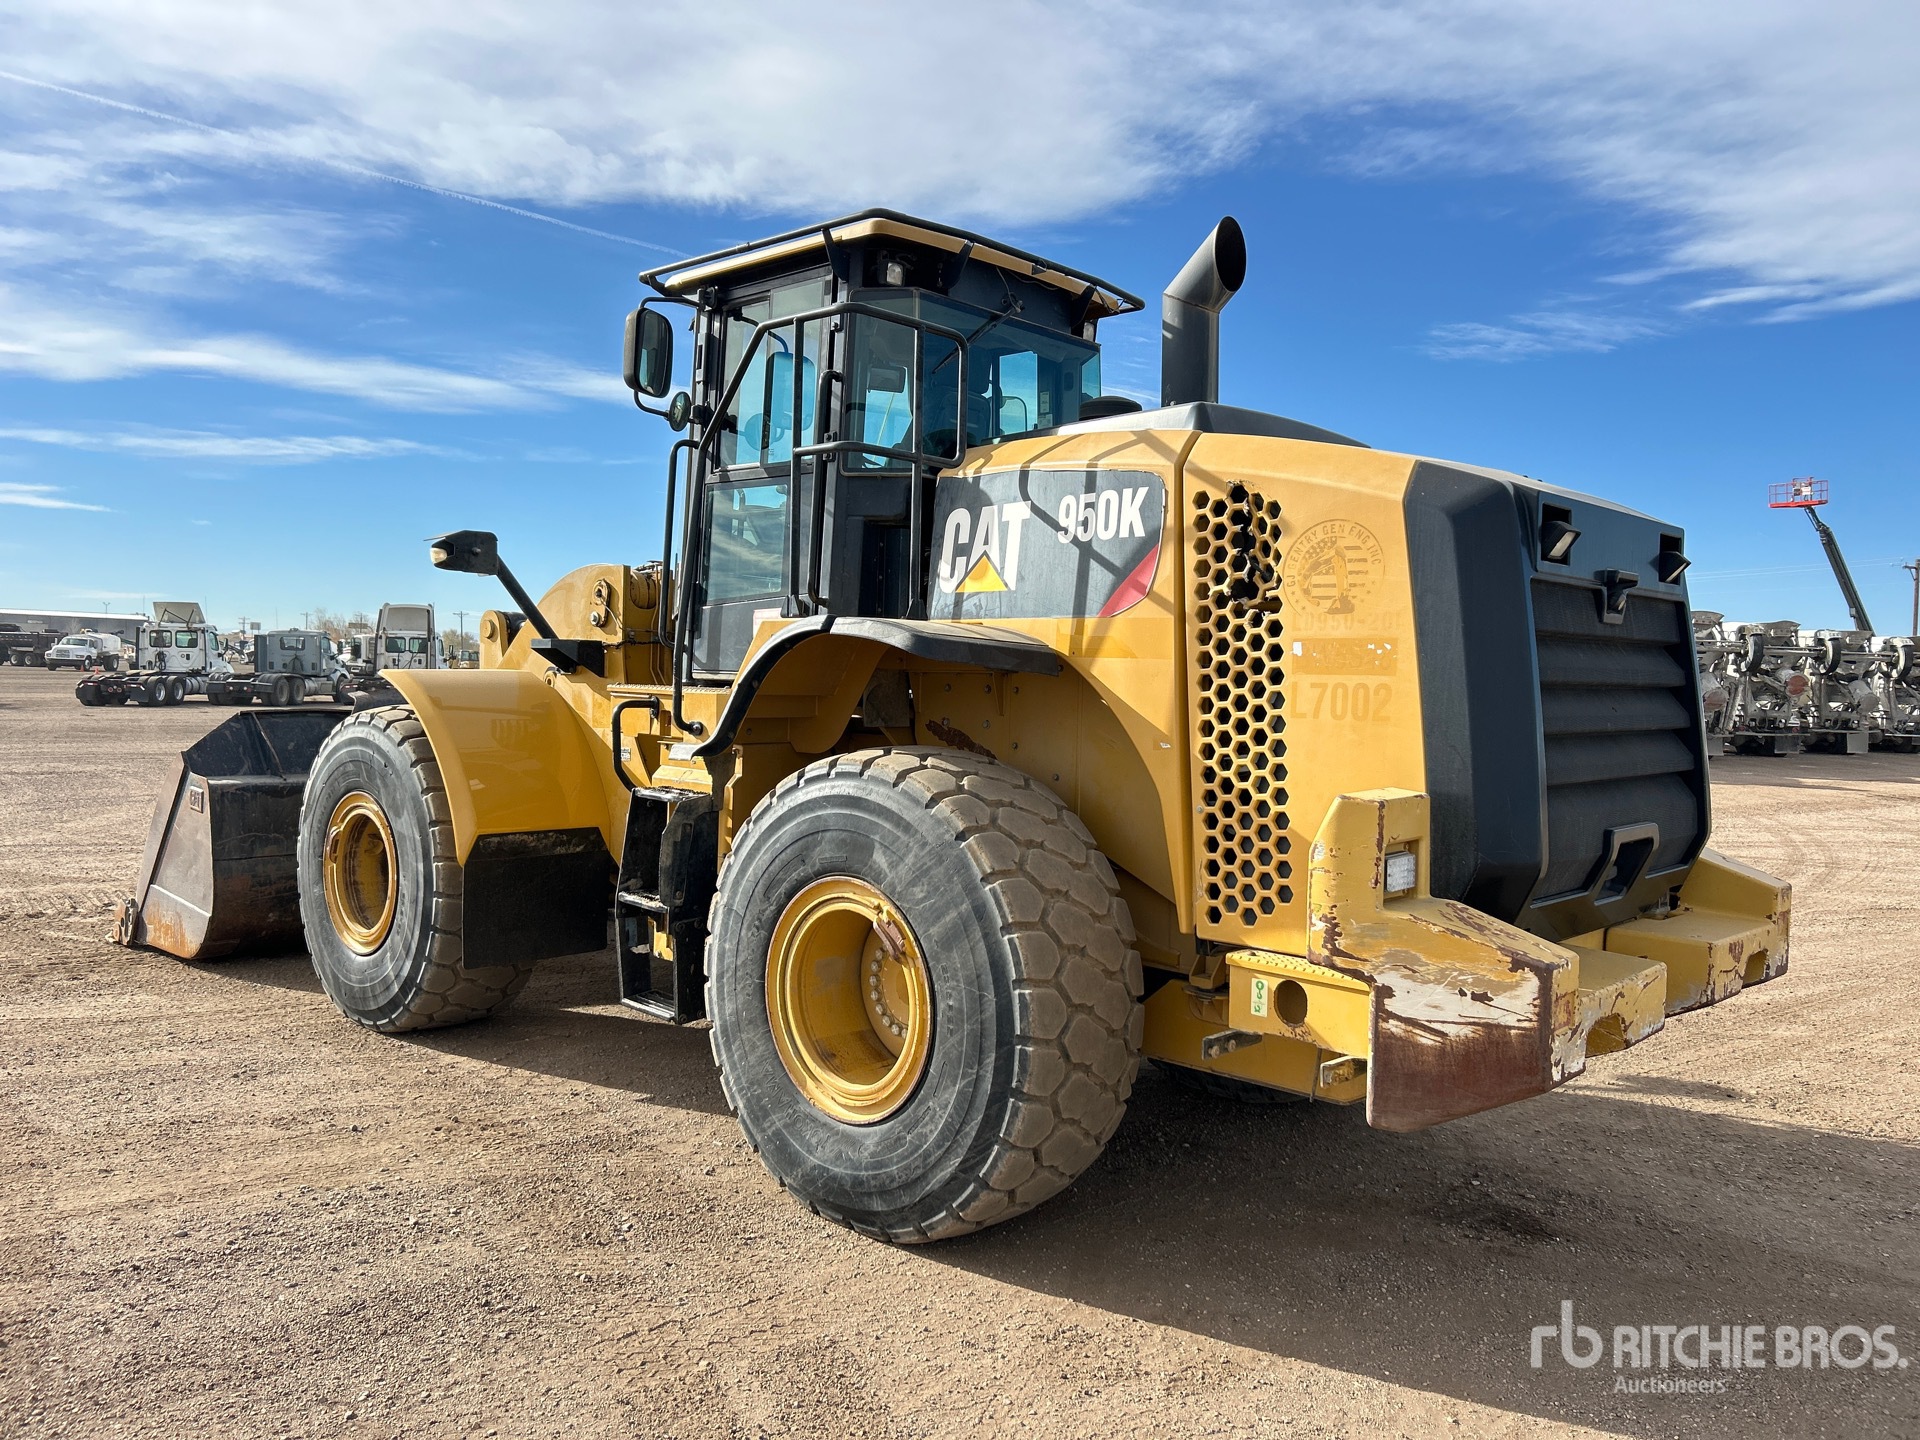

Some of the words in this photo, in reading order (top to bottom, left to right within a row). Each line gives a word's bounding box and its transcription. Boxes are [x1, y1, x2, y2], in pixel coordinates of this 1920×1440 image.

[1058, 486, 1150, 543] 950K
[939, 500, 1032, 593] CAT
[1287, 530, 1318, 569] GENTRY
[1322, 523, 1346, 535] GEN
[1348, 525, 1371, 545] ENG
[1366, 544, 1382, 566] INC
[1290, 682, 1393, 722] L7002
